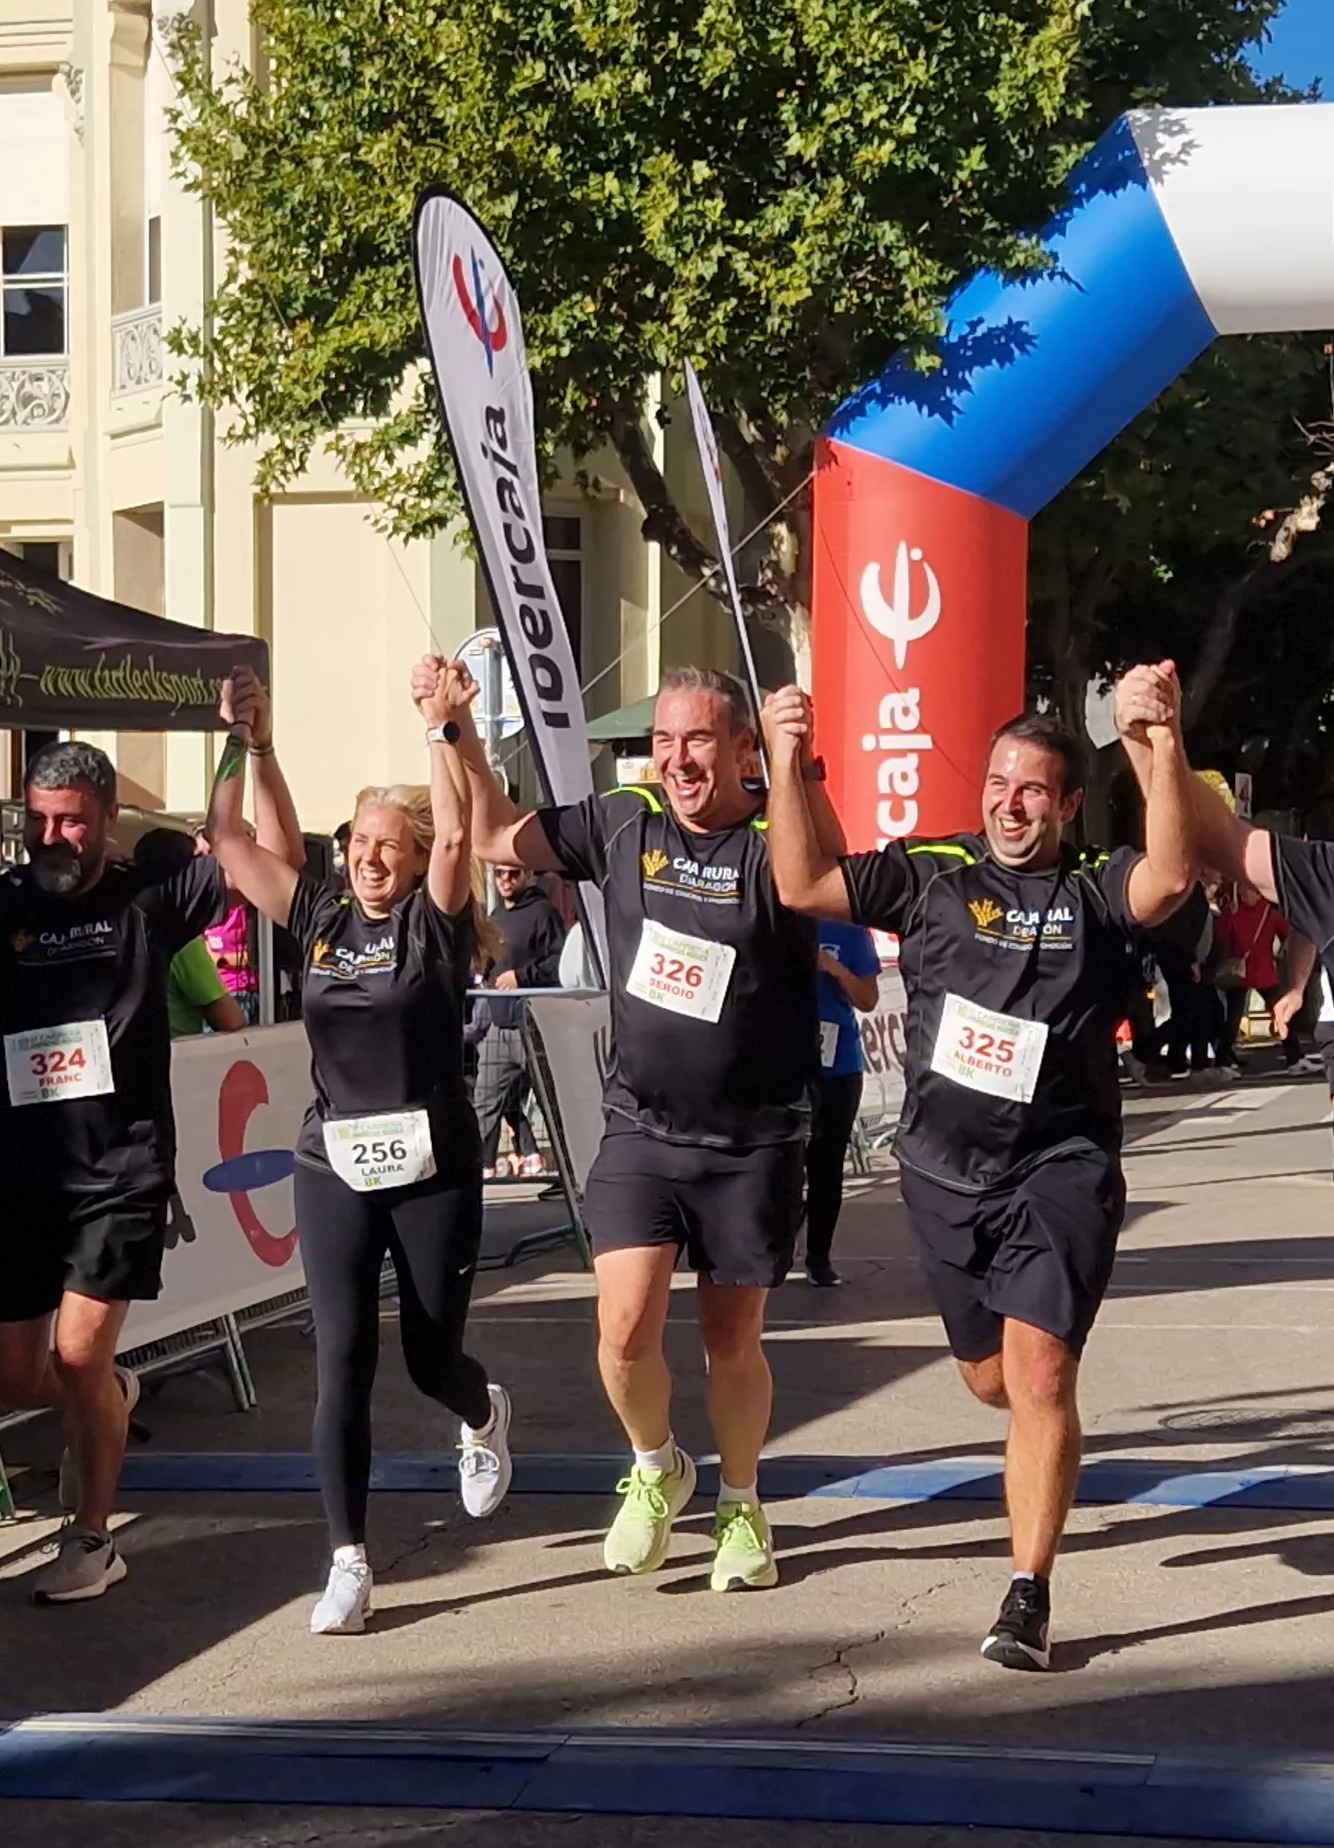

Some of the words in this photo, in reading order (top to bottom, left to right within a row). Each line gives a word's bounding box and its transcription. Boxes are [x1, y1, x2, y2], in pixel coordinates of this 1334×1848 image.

[650, 952, 705, 988] 326
[958, 1025, 1017, 1064] 325
[29, 1047, 87, 1076] 324
[953, 1050, 1013, 1078] ALBERTO
[38, 1072, 83, 1088] FRANC
[351, 1139, 408, 1165] 256
[361, 1163, 405, 1177] LAURA
